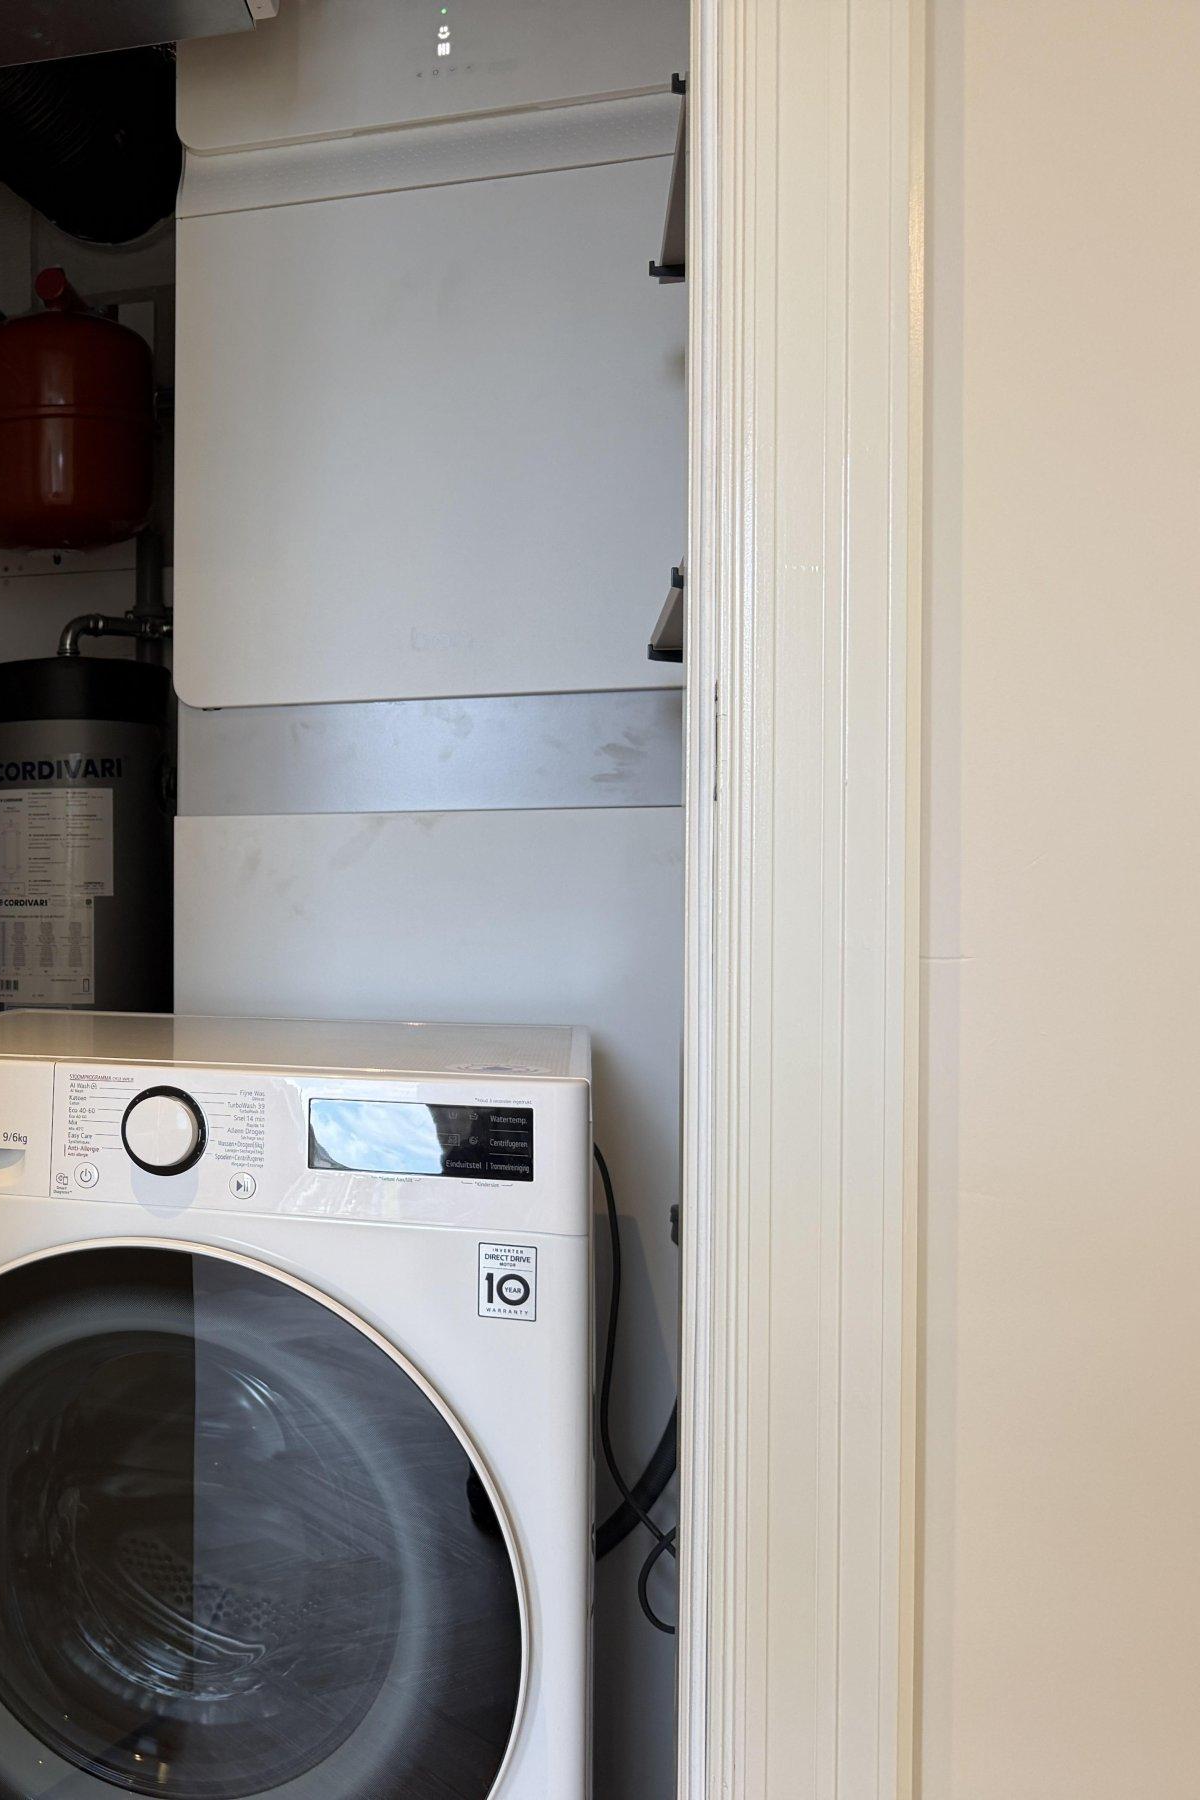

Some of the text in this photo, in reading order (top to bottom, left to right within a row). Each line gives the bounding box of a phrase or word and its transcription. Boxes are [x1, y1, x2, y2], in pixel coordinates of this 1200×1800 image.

[4, 898, 48, 908] CORDIVARI
[490, 1115, 528, 1125] Watertemp.
[2, 1132, 28, 1145] 9/6kg
[489, 1138, 528, 1149] Centrifugeren
[445, 1159, 482, 1169] Einduitstel
[484, 1253, 532, 1263] DIRECT DRIVE
[484, 1272, 531, 1306] 10
[504, 1286, 522, 1294] YEAR
